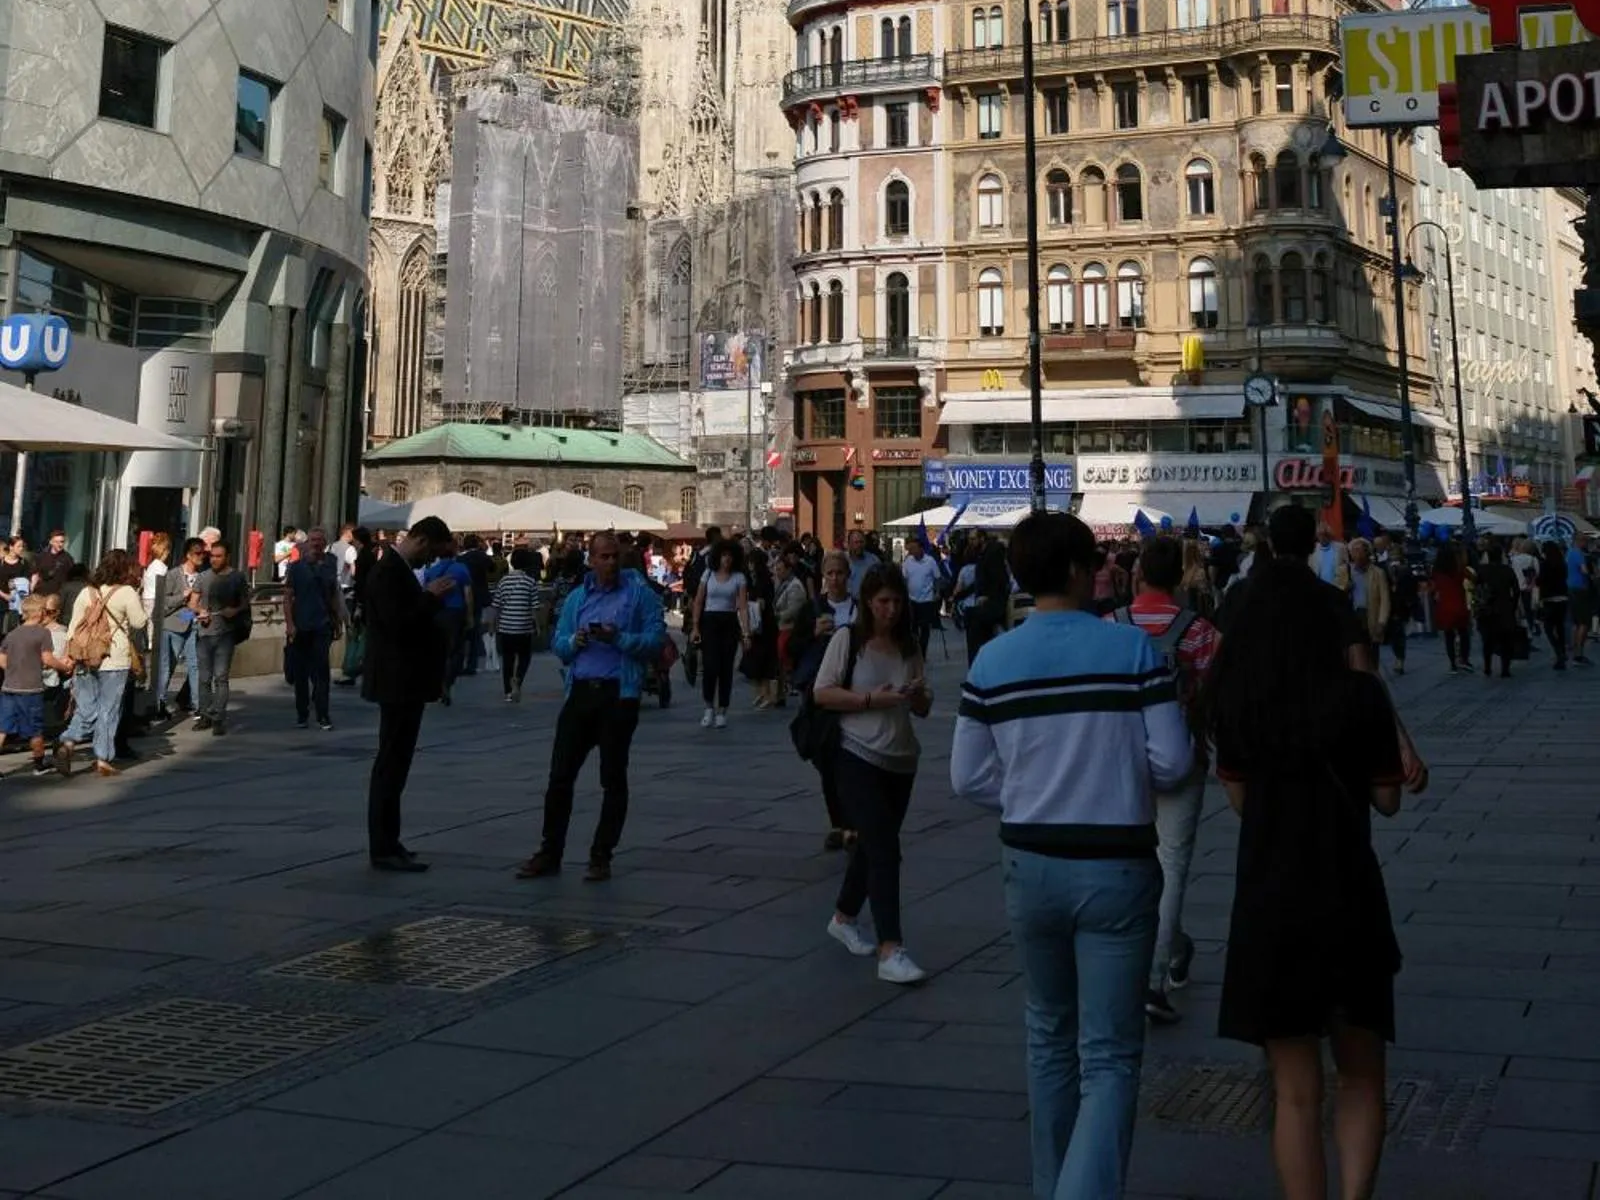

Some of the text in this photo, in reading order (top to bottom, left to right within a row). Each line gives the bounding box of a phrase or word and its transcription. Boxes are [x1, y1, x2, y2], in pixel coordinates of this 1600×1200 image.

[1, 324, 30, 362] U
[44, 325, 68, 363] U
[947, 469, 997, 489] MONEY
[999, 469, 1072, 489] EXCNGE
[1135, 464, 1257, 483] KONDITOREI
[1276, 459, 1354, 489] Aia
